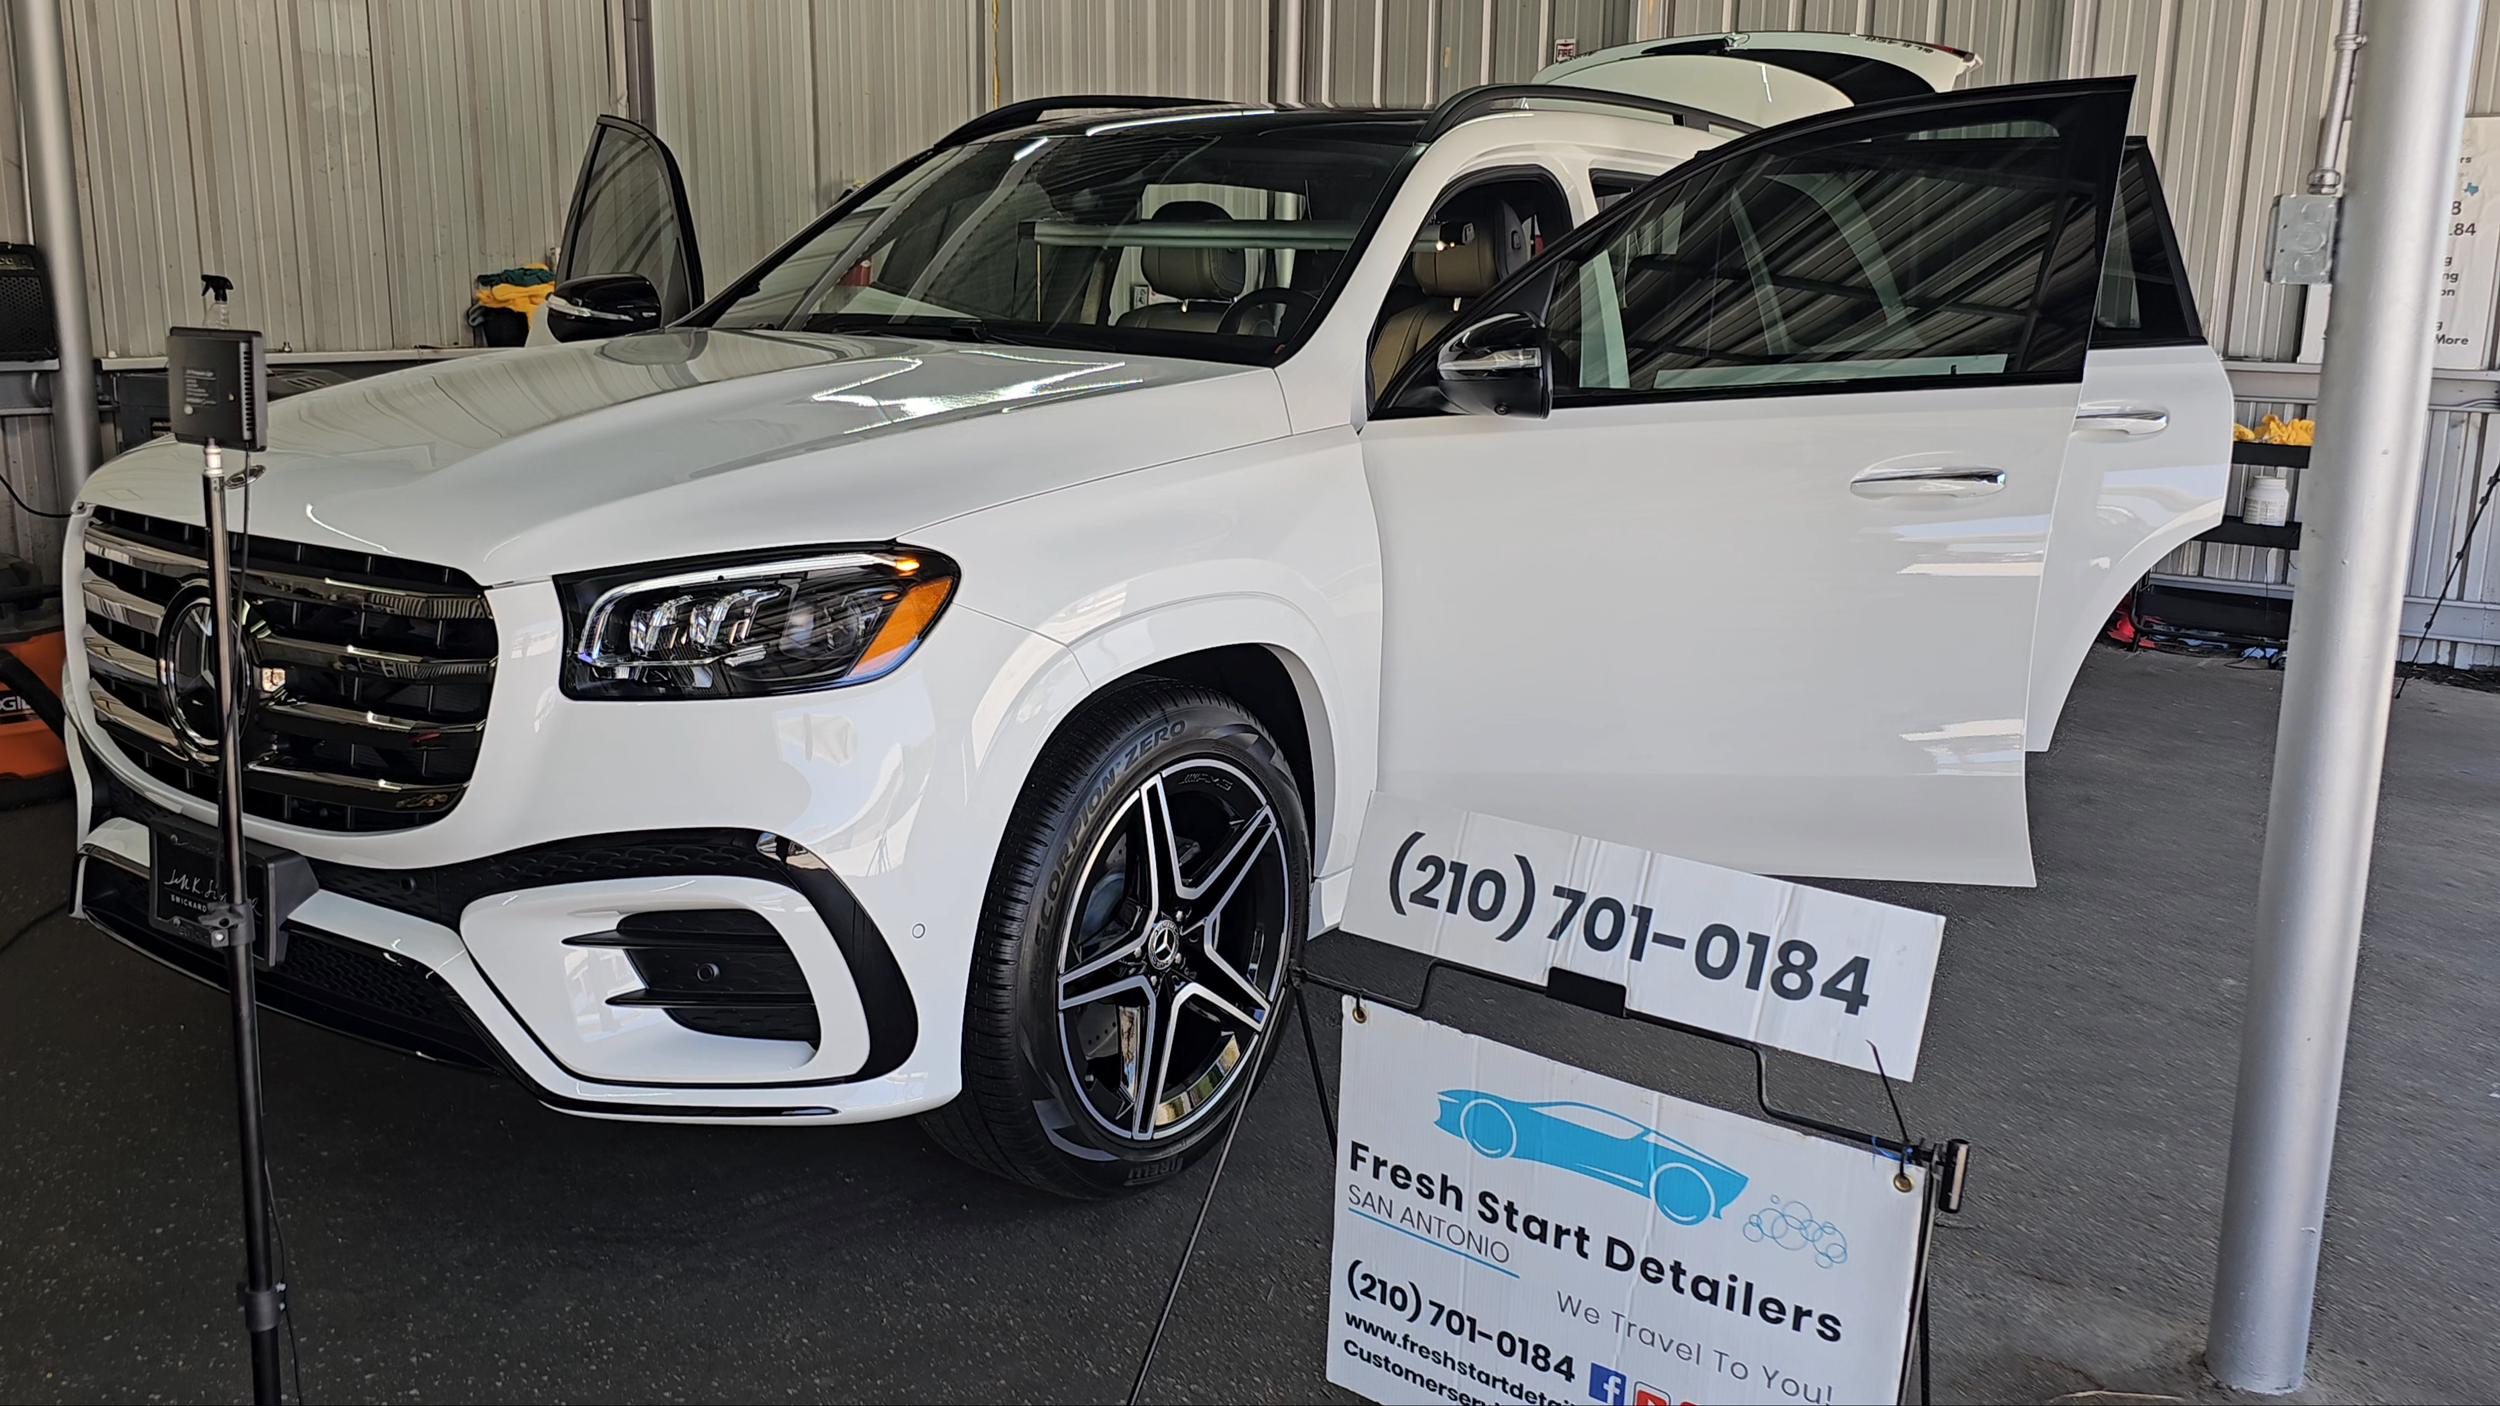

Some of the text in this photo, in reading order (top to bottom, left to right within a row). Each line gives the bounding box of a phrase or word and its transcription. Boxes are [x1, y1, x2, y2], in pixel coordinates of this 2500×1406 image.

[1034, 766, 1116, 945] SCORPION
[1124, 718, 1187, 772] ZERO
[170, 894, 207, 913] SWICKARD
[1389, 831, 1871, 1016] (210) 701-0184
[1348, 1184, 1510, 1263] SAN ANTONIO
[1350, 1141, 1842, 1342] Fresh Start Detailers
[1345, 1312, 1576, 1406] www.freshstartdet
[1347, 1259, 1576, 1383] (210) 701-0184
[1556, 1290, 1832, 1405] We Travel To You!
